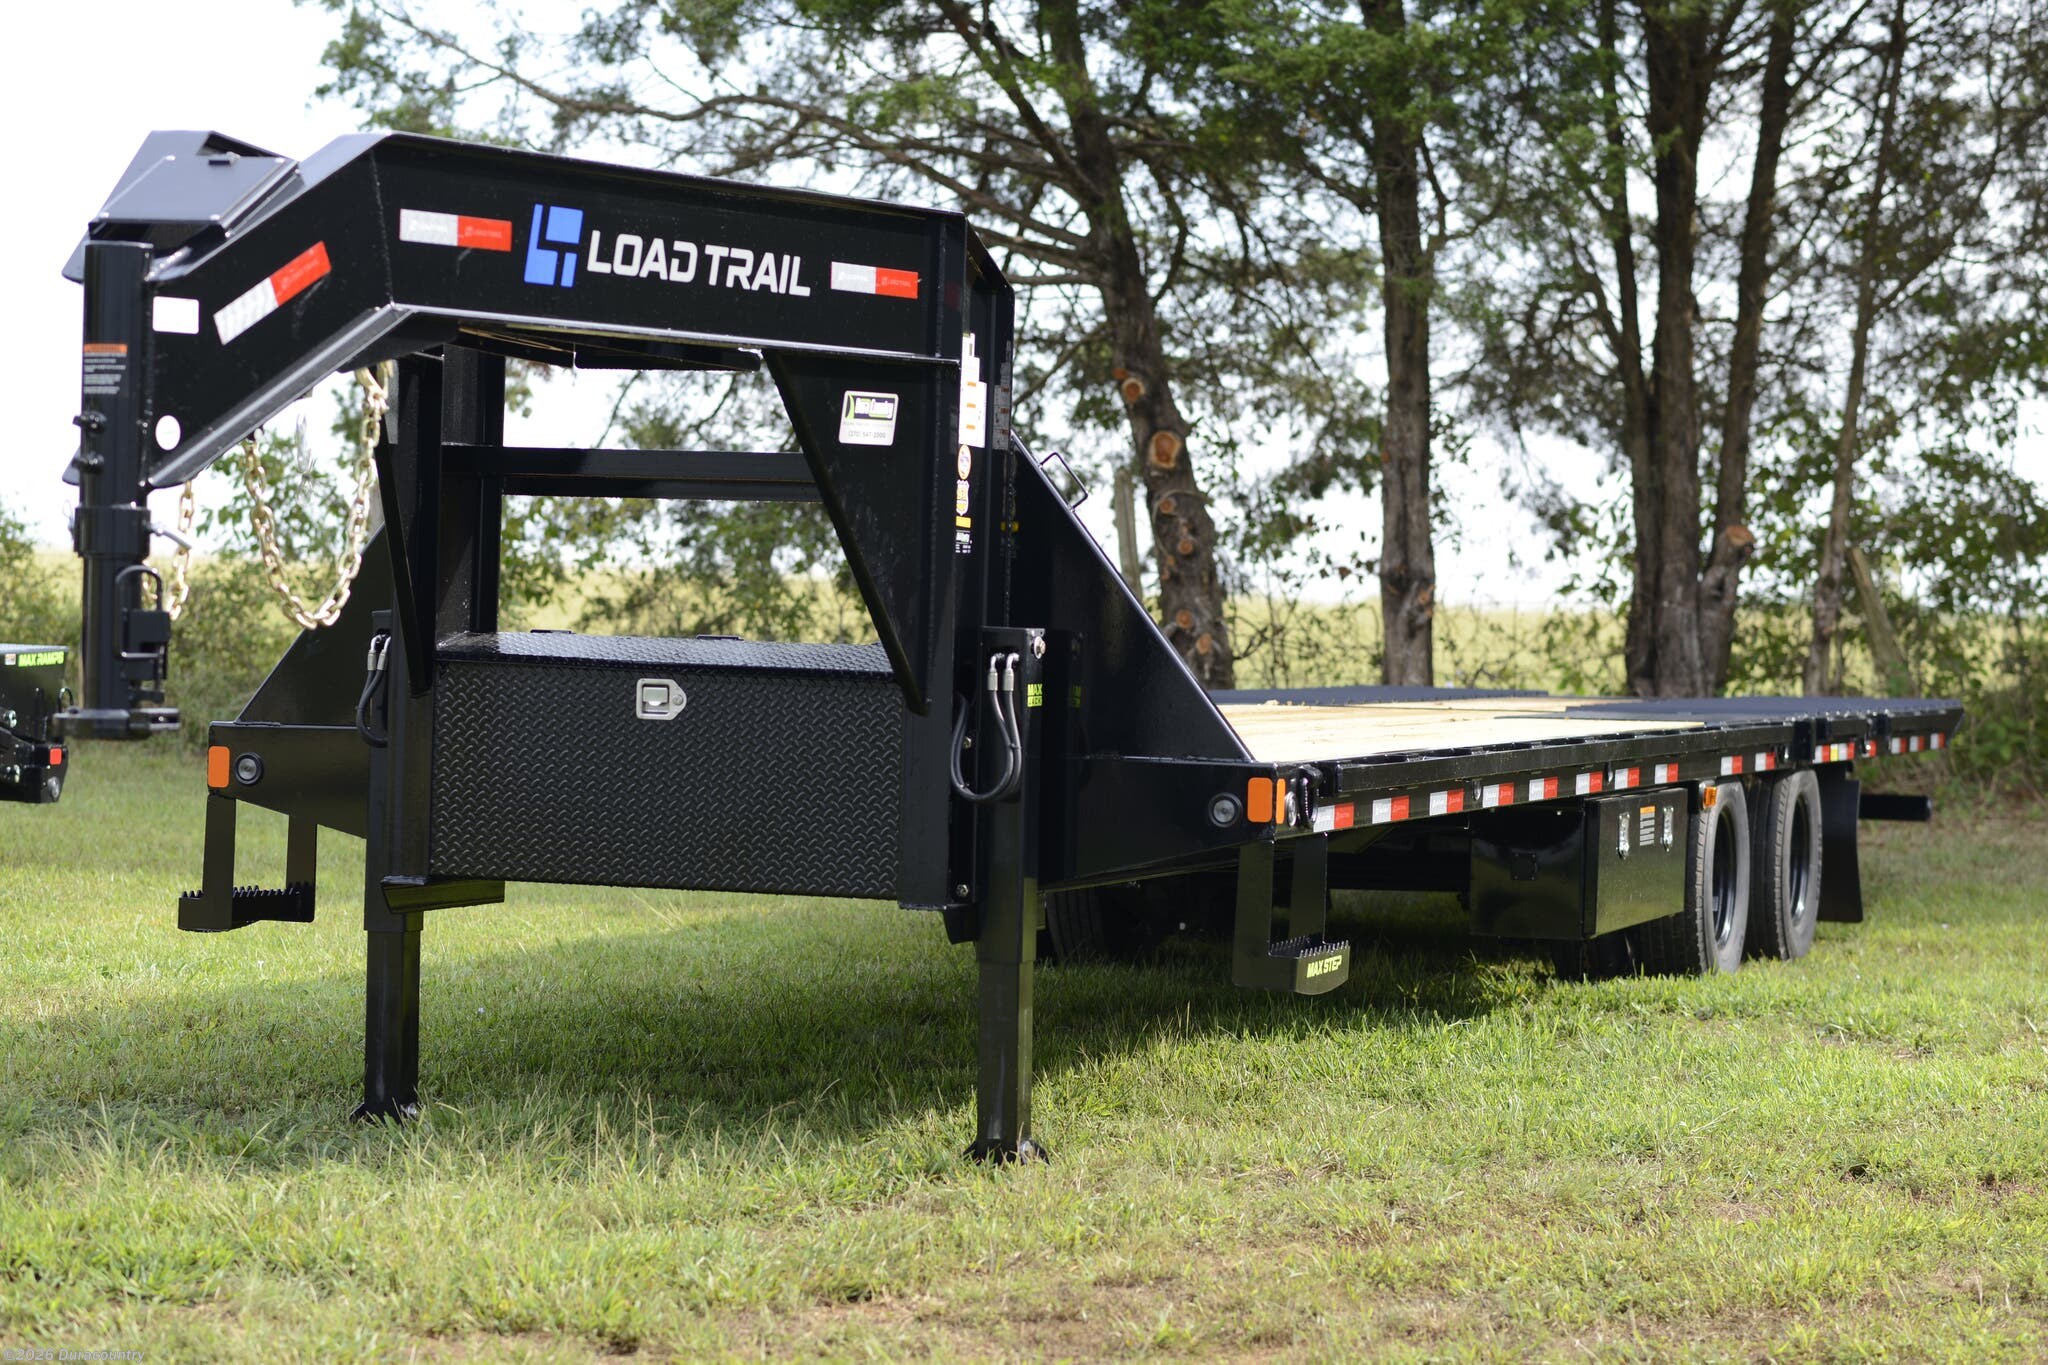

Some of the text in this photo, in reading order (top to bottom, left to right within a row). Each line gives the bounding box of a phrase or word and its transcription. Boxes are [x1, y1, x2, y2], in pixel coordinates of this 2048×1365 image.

[587, 230, 811, 297] LOAD TRAIL
[18, 652, 36, 667] MAX
[1027, 683, 1043, 696] MAX
[1306, 955, 1343, 978] MAX STEP
